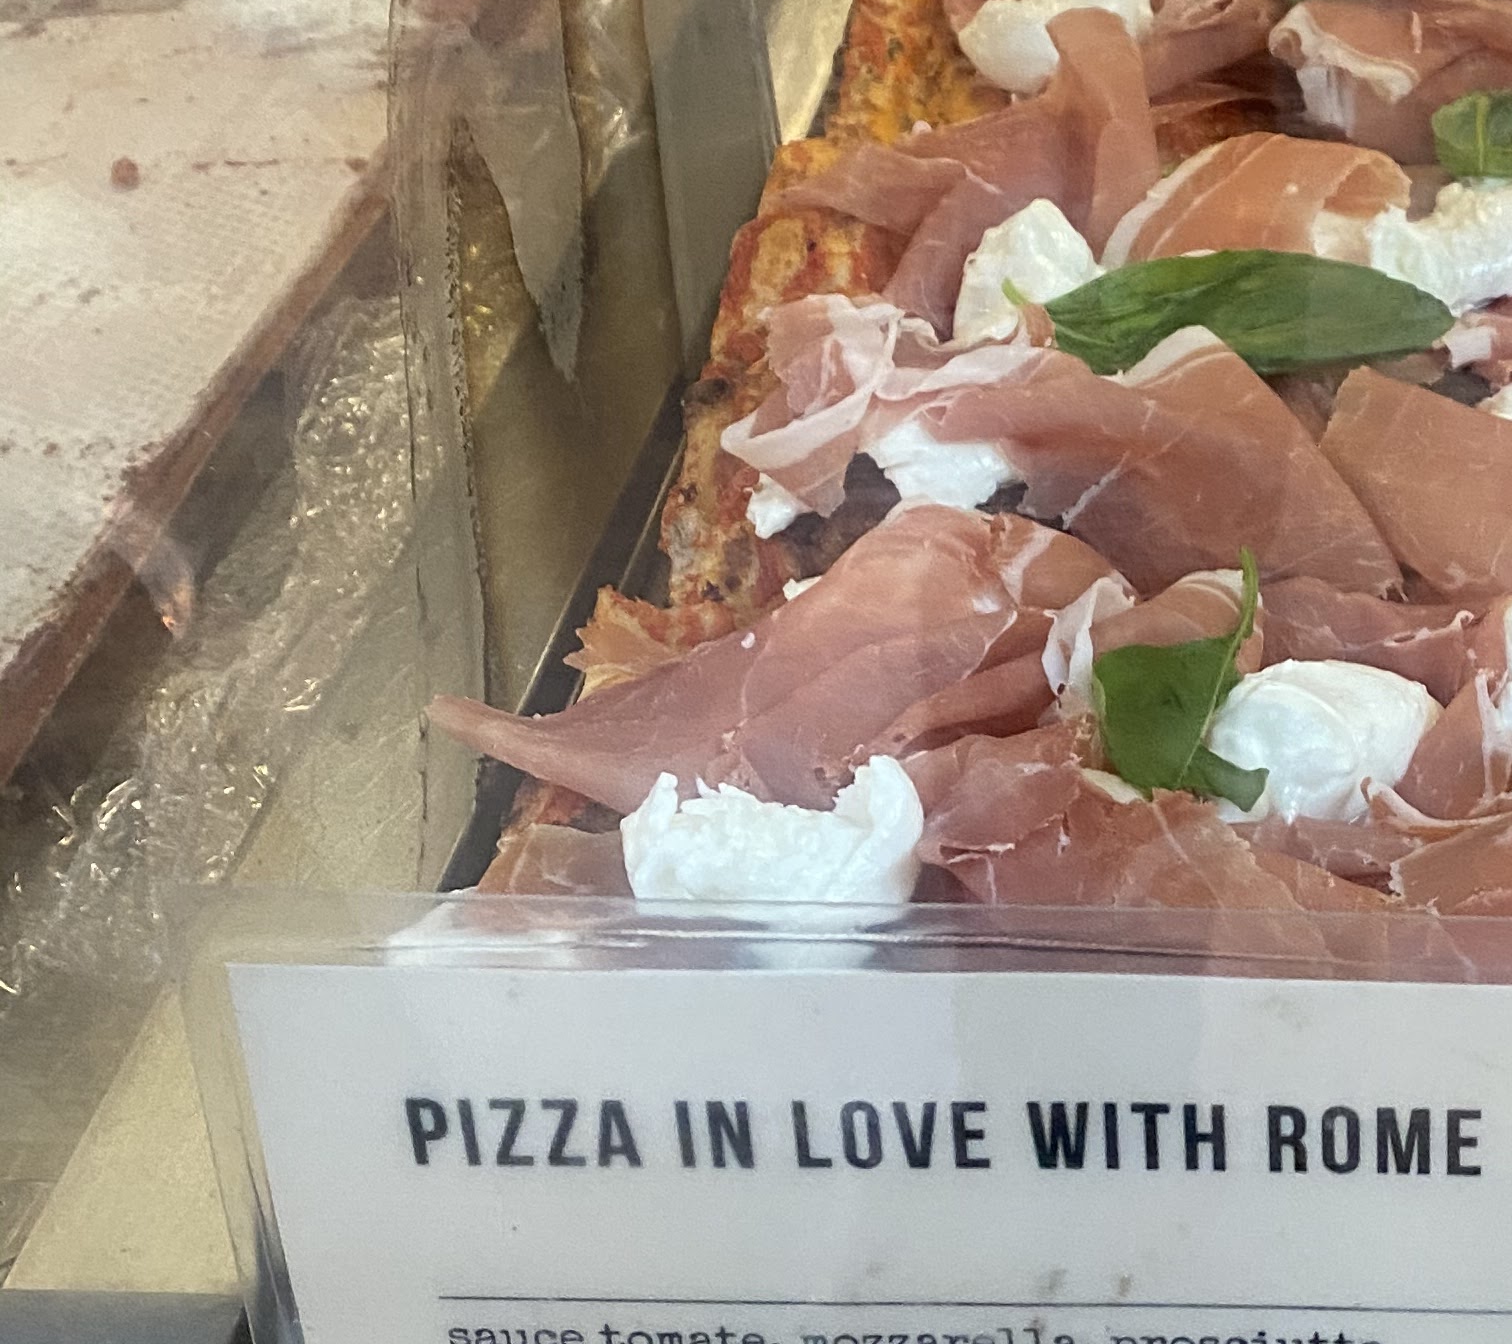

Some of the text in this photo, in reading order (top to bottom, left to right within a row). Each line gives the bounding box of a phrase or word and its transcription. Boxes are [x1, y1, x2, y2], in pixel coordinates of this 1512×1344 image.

[402, 1095, 1484, 1179] PIZZA IN LOVE WITH ROME
